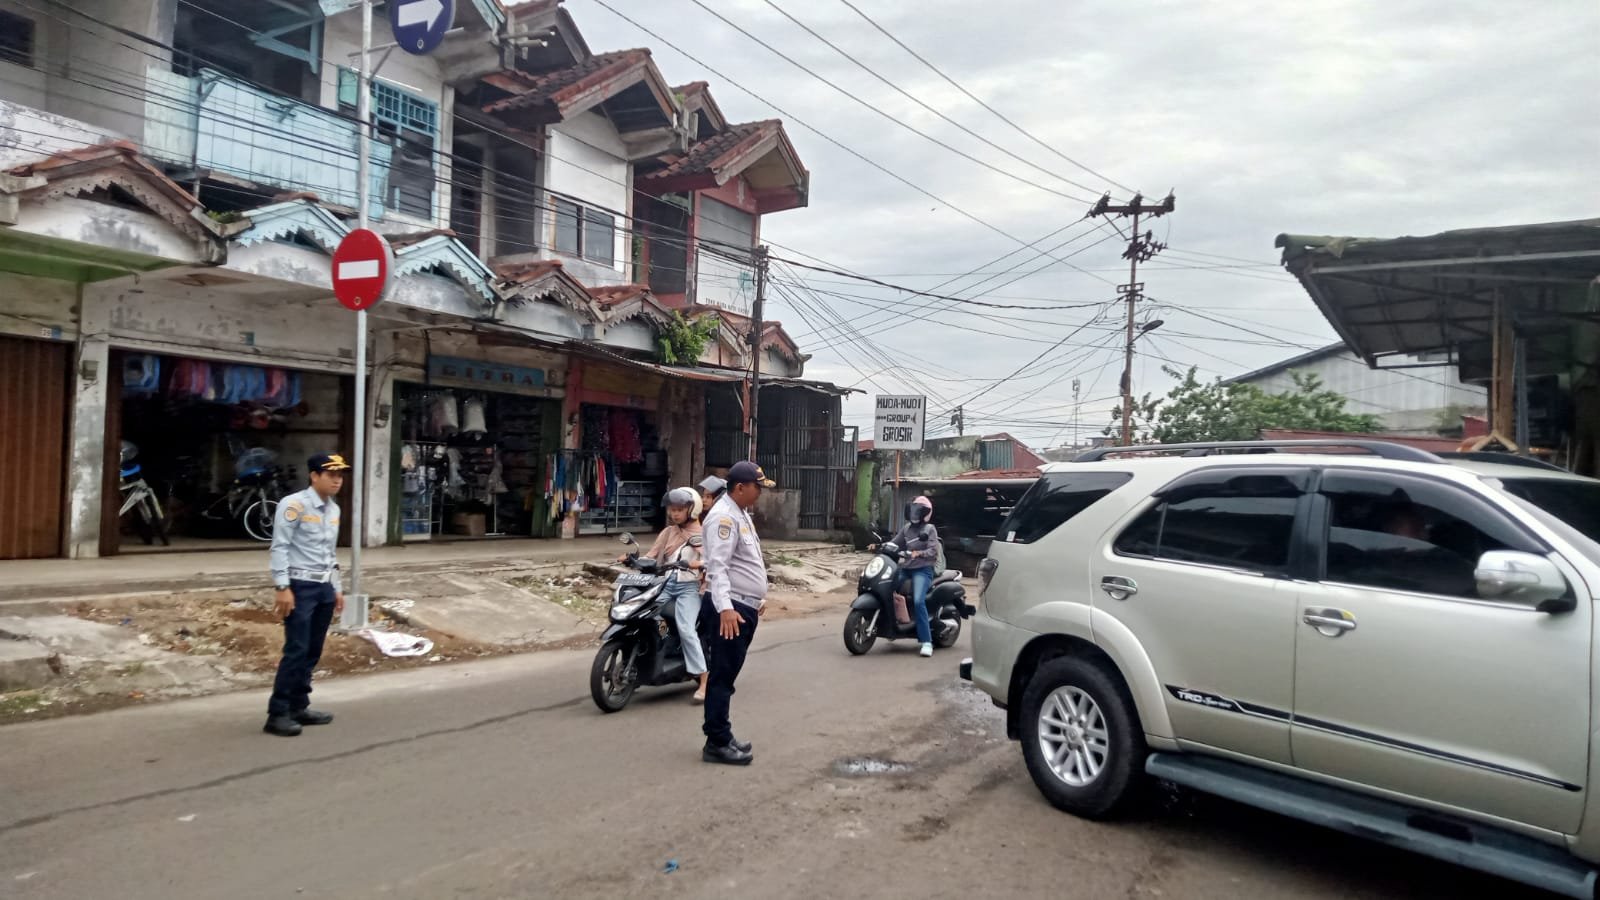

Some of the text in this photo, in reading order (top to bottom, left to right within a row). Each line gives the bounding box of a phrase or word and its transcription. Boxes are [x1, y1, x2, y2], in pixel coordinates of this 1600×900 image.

[876, 397, 921, 409] MUDA-MUDI
[886, 414, 911, 423] GROUP
[882, 426, 913, 442] GROSIR
